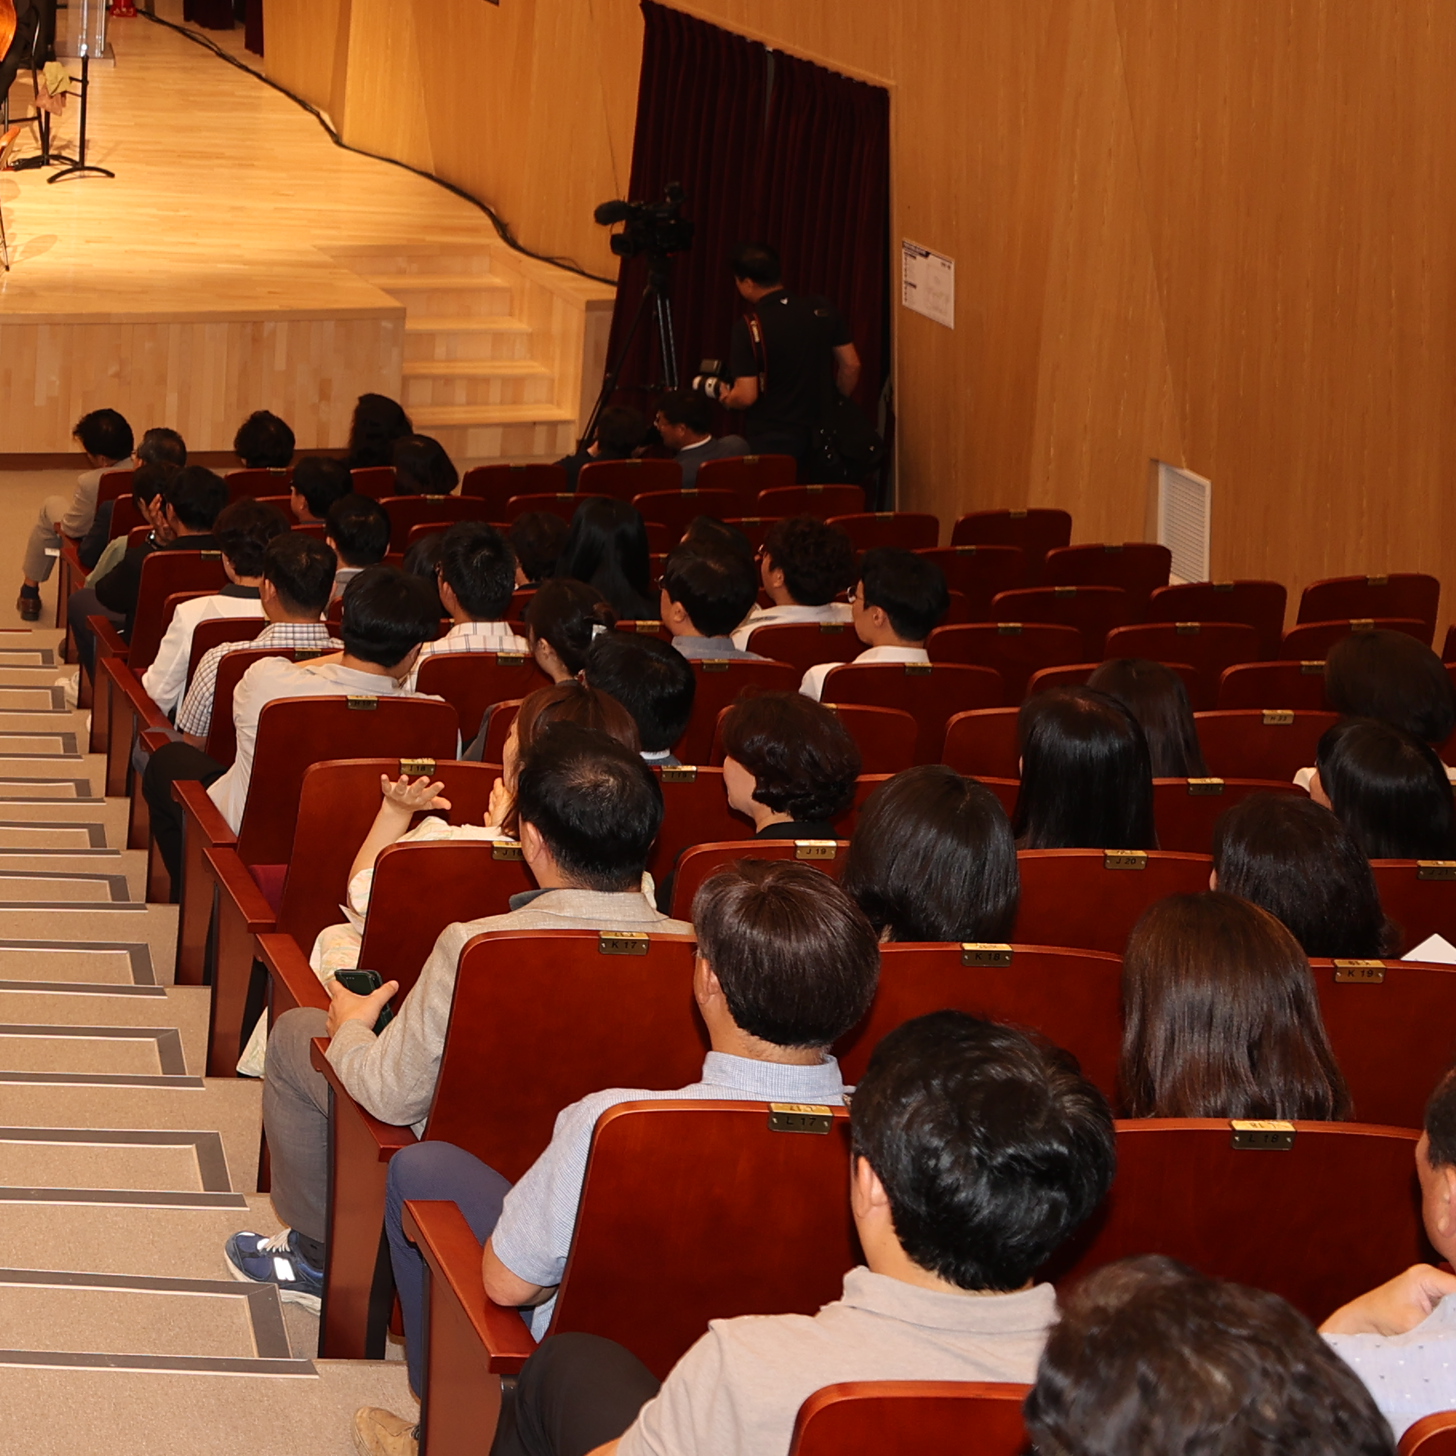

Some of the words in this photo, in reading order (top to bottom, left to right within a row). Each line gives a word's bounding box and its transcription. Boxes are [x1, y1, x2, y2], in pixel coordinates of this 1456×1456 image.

[612, 941, 619, 949] K
[624, 941, 637, 949] 17
[975, 953, 982, 961] K
[988, 953, 1000, 961] 18
[785, 1116, 794, 1125] L
[802, 1116, 817, 1126] 17
[1248, 1134, 1256, 1143] L
[1264, 1134, 1279, 1143] 18
